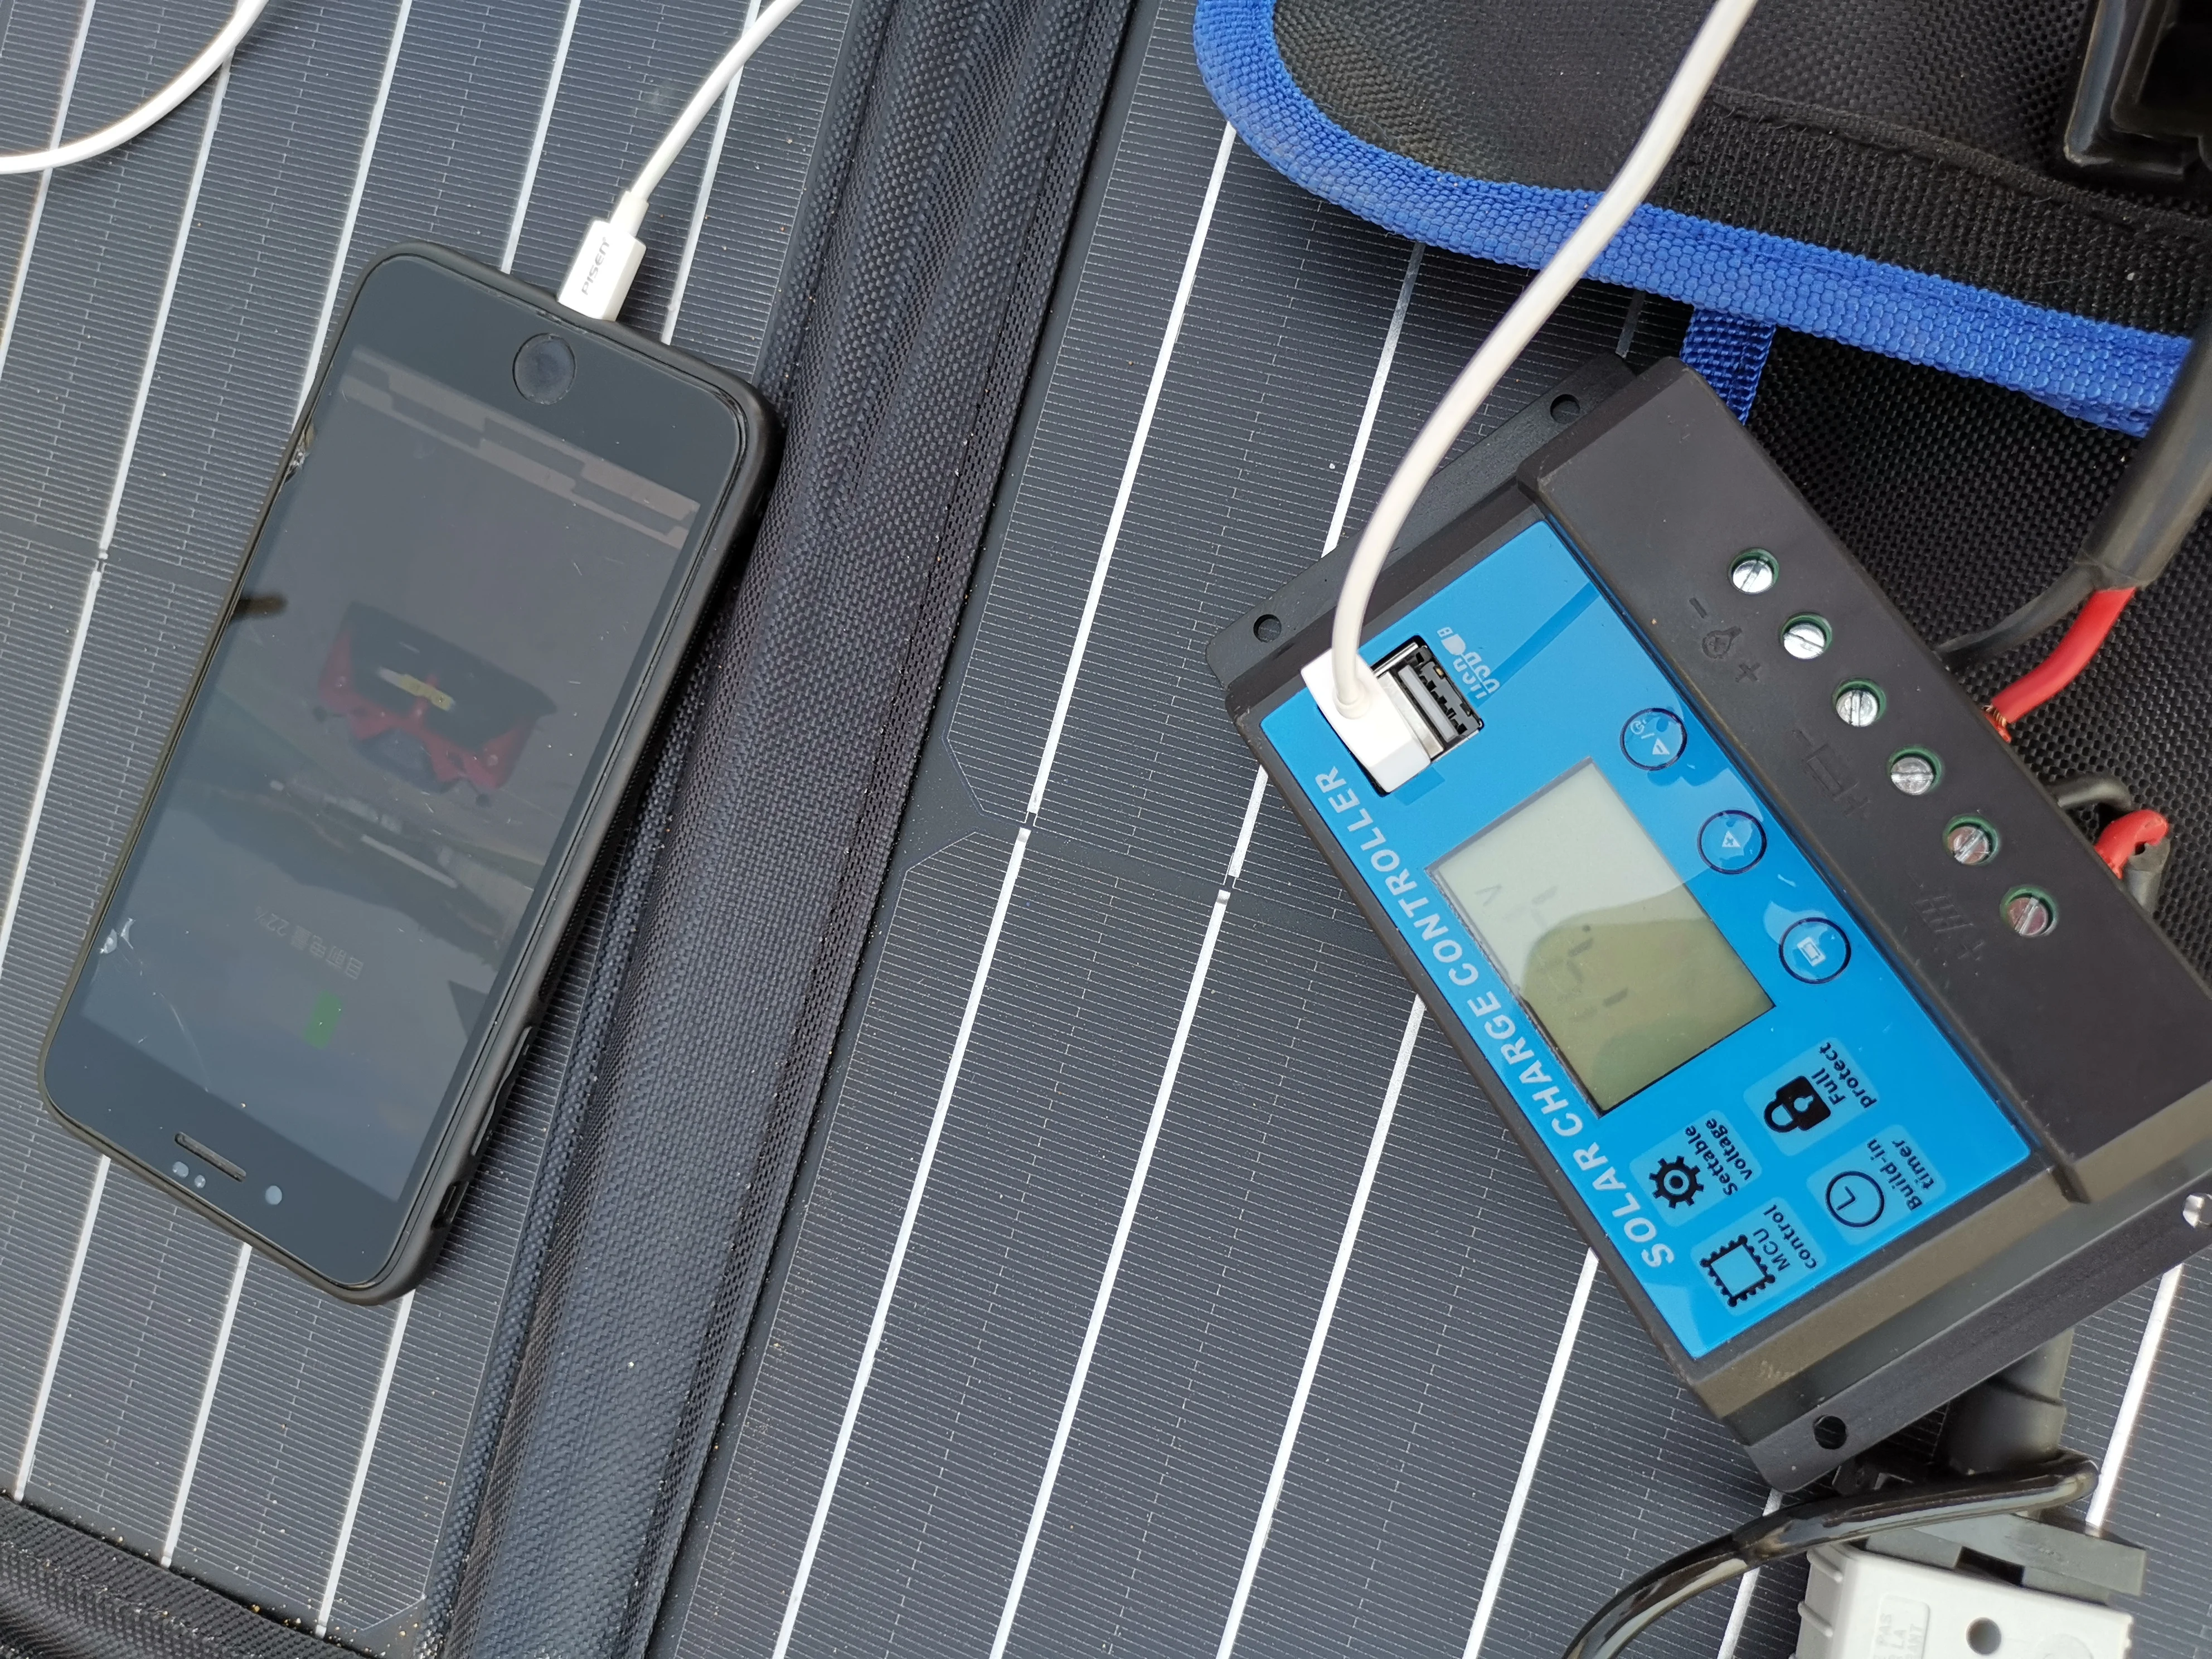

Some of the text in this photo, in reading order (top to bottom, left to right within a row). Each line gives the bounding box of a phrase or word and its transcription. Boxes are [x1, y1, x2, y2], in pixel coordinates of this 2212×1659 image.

[581, 240, 610, 296] PISEN
[290, 925, 363, 979] 目前电量
[1315, 766, 1674, 1267] SOLAR CHARGE CONTROLLER
[1811, 1067, 1847, 1105] Full
[1819, 1042, 1877, 1108] protect
[1685, 1125, 1738, 1195] Settable
[1705, 1118, 1752, 1180] voltage
[1866, 1138, 1922, 1211] Build-in
[1891, 1140, 1934, 1190] timer
[1753, 1228, 1791, 1272] MCU
[1763, 1204, 1817, 1269] control
